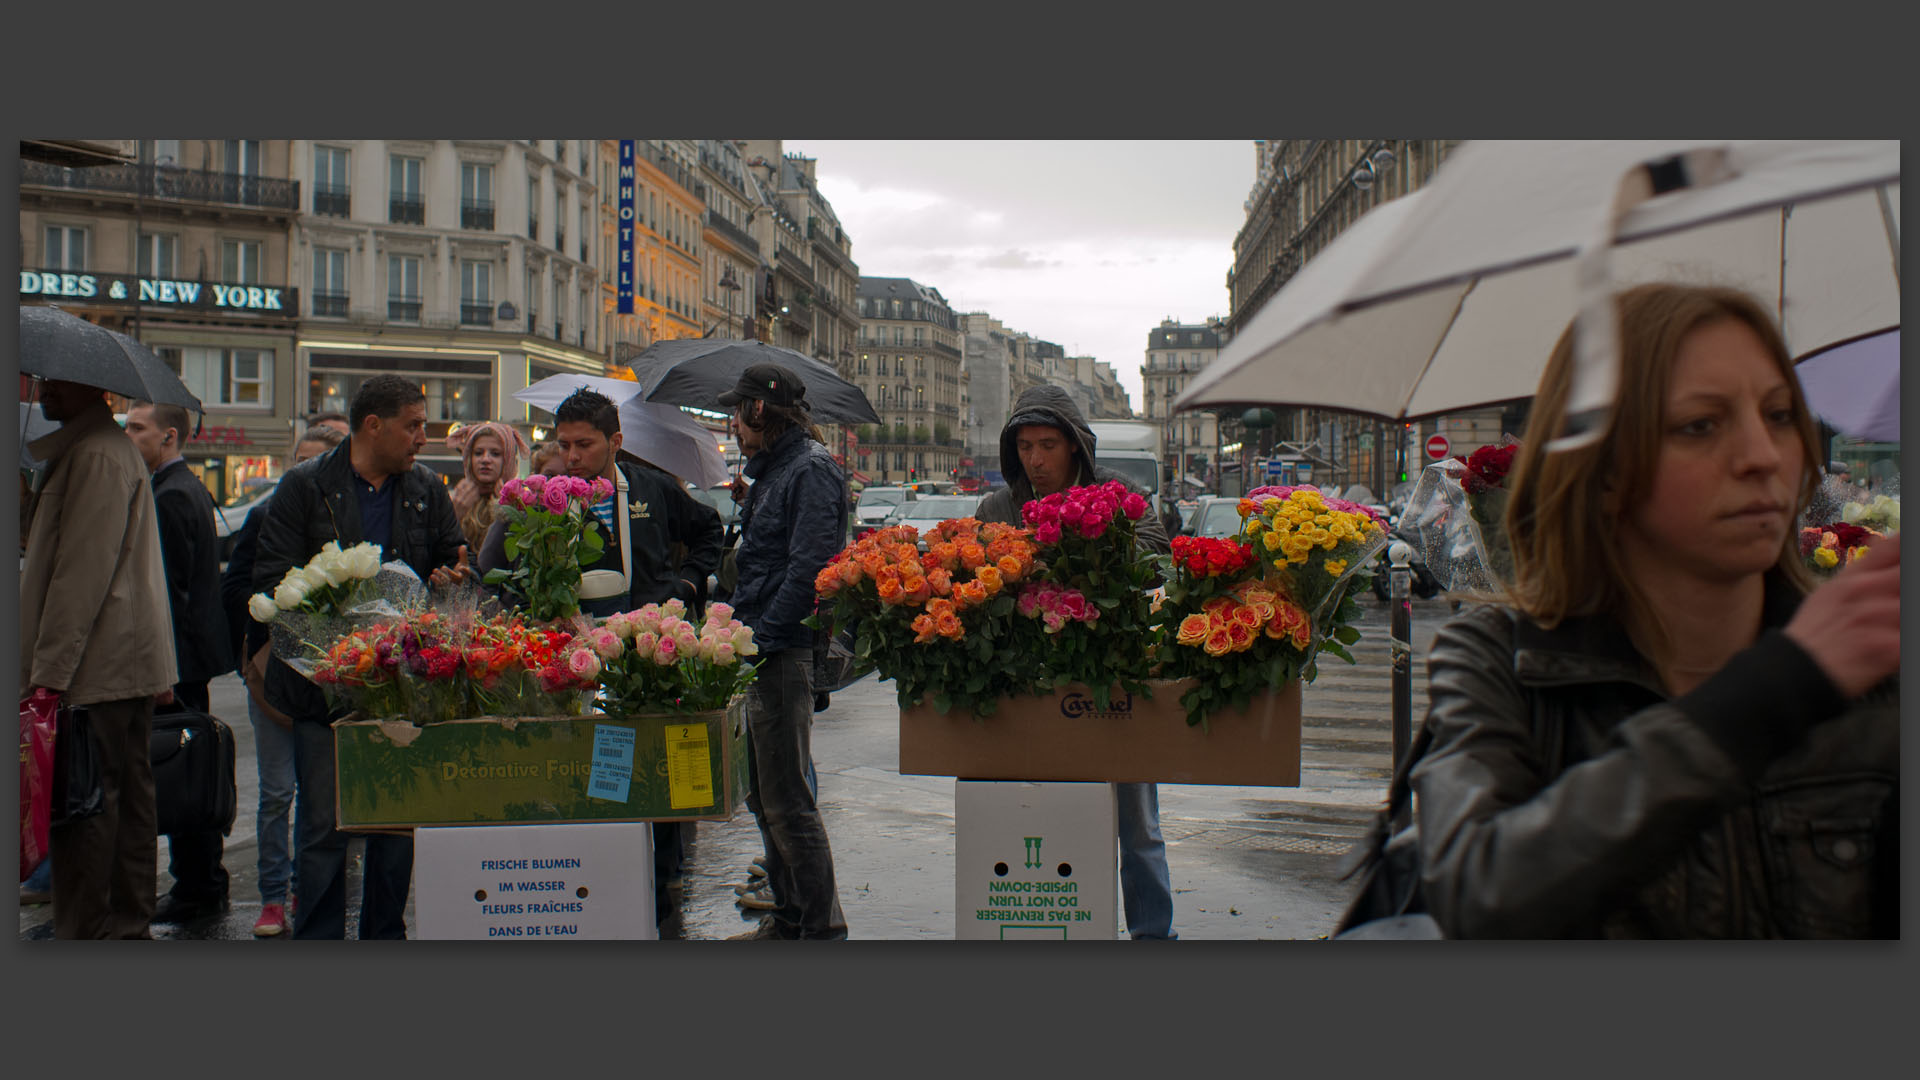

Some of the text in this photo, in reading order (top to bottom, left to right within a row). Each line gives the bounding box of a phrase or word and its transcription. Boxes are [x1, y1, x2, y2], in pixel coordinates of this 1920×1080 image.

[109, 280, 127, 299] &
[139, 280, 201, 304] NEW
[213, 284, 282, 310] YORK
[682, 727, 689, 738] 2
[442, 761, 539, 781] Decorative
[481, 858, 581, 870] FRISCHE BLUMEN
[498, 880, 566, 892] IM WASSER
[989, 881, 1078, 893] UPSIDE-DOWN
[482, 900, 584, 914] FLEURS FRAÎCHES
[988, 896, 1078, 907] DO NOT TURN
[976, 910, 1092, 922] NE PAS RENVERSER
[488, 924, 578, 937] DANS DE L'EAU
